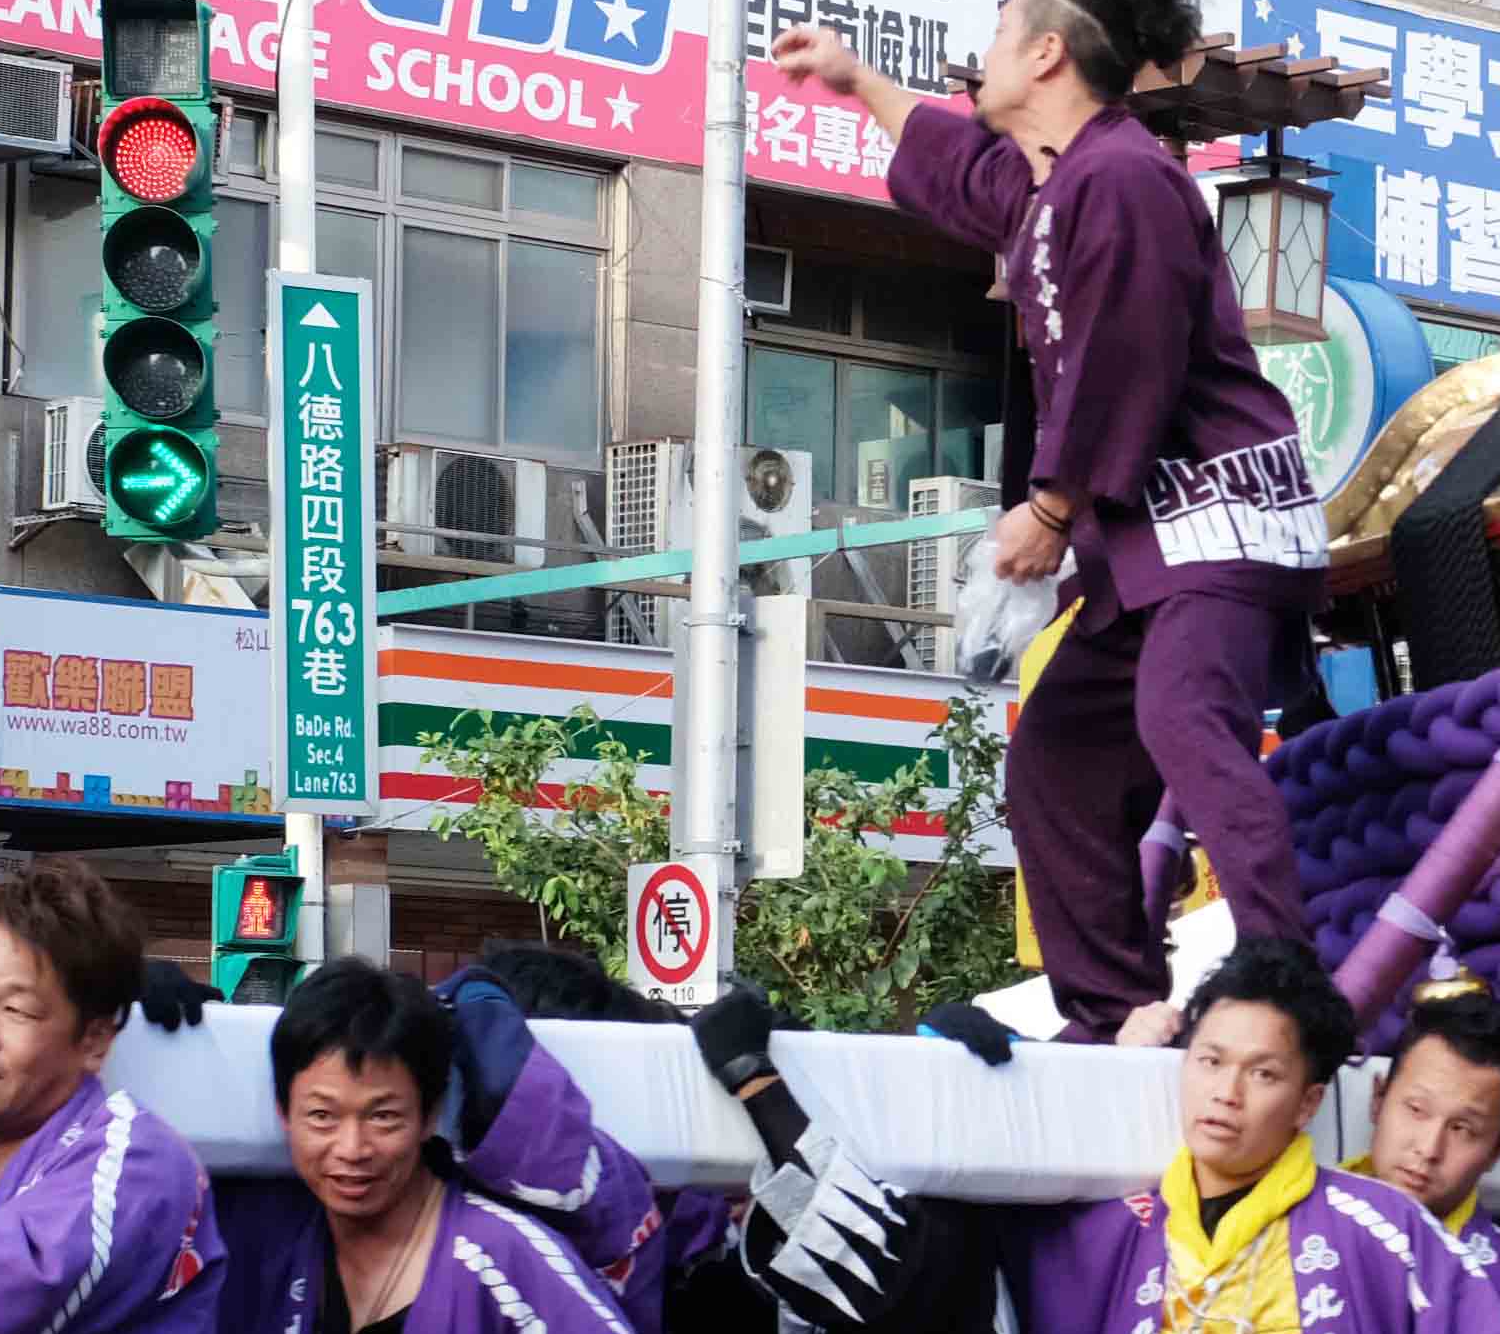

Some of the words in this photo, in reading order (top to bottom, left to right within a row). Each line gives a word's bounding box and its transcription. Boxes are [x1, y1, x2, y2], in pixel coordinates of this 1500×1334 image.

[366, 38, 599, 131] SCHOOL
[290, 340, 357, 696] 八德路四段763巷
[3, 649, 195, 721] 歡樂聯盟
[7, 711, 188, 744] www.wa88.com.tw
[295, 713, 331, 737] BaDe
[334, 715, 356, 738] Rd.
[307, 741, 344, 767] Sec.4
[294, 768, 357, 795] Lane763
[653, 892, 690, 953] 停
[671, 986, 695, 1002] 110
